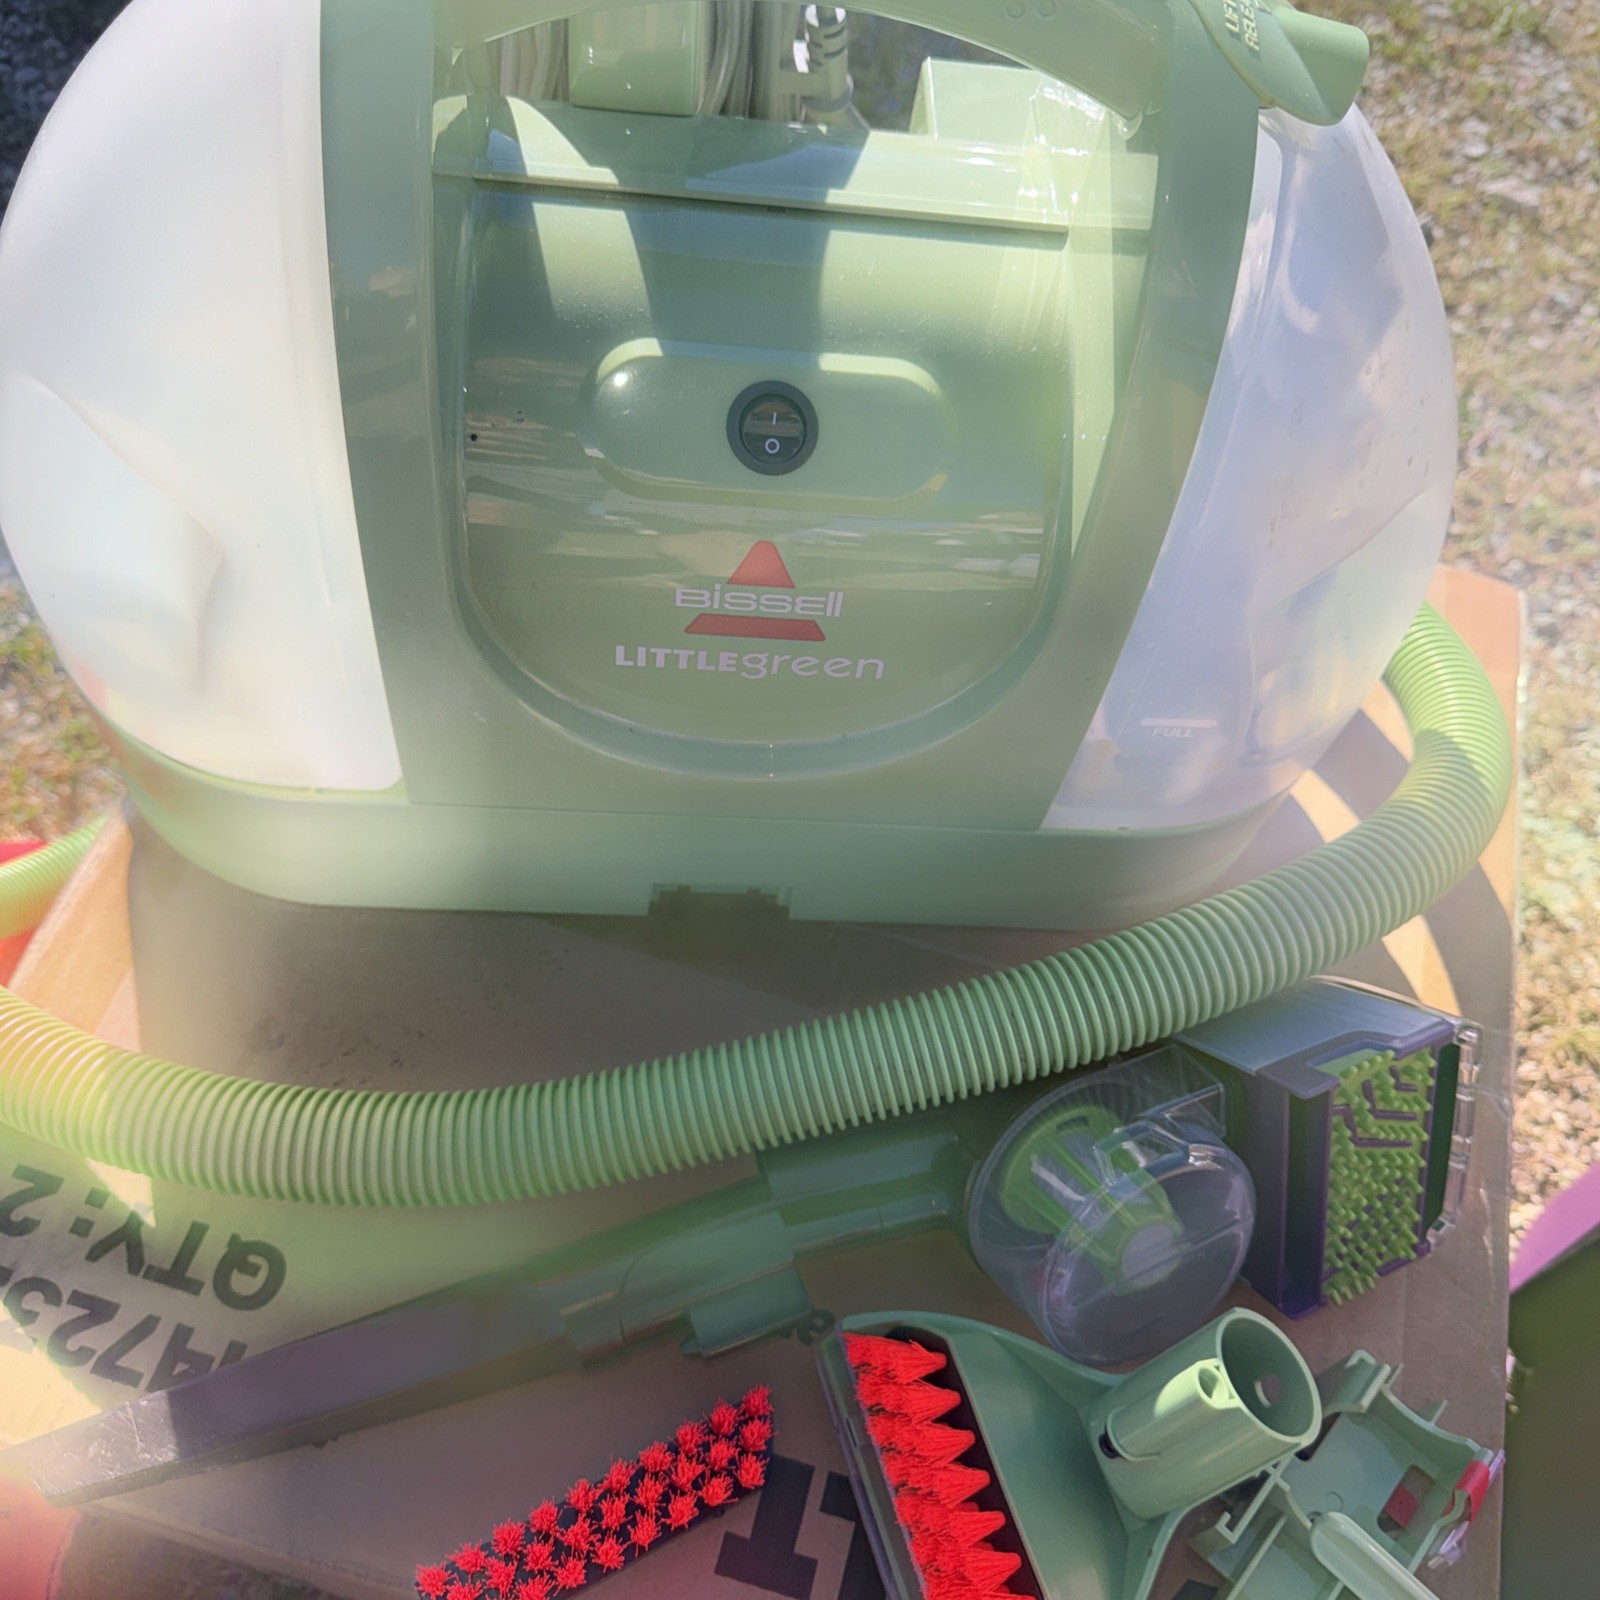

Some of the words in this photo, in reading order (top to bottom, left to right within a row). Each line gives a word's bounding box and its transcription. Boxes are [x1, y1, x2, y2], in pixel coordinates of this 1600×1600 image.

[615, 645, 885, 679] LITTLEgreen
[1152, 727, 1193, 738] FULL
[68, 1187, 287, 1311] QTY:
